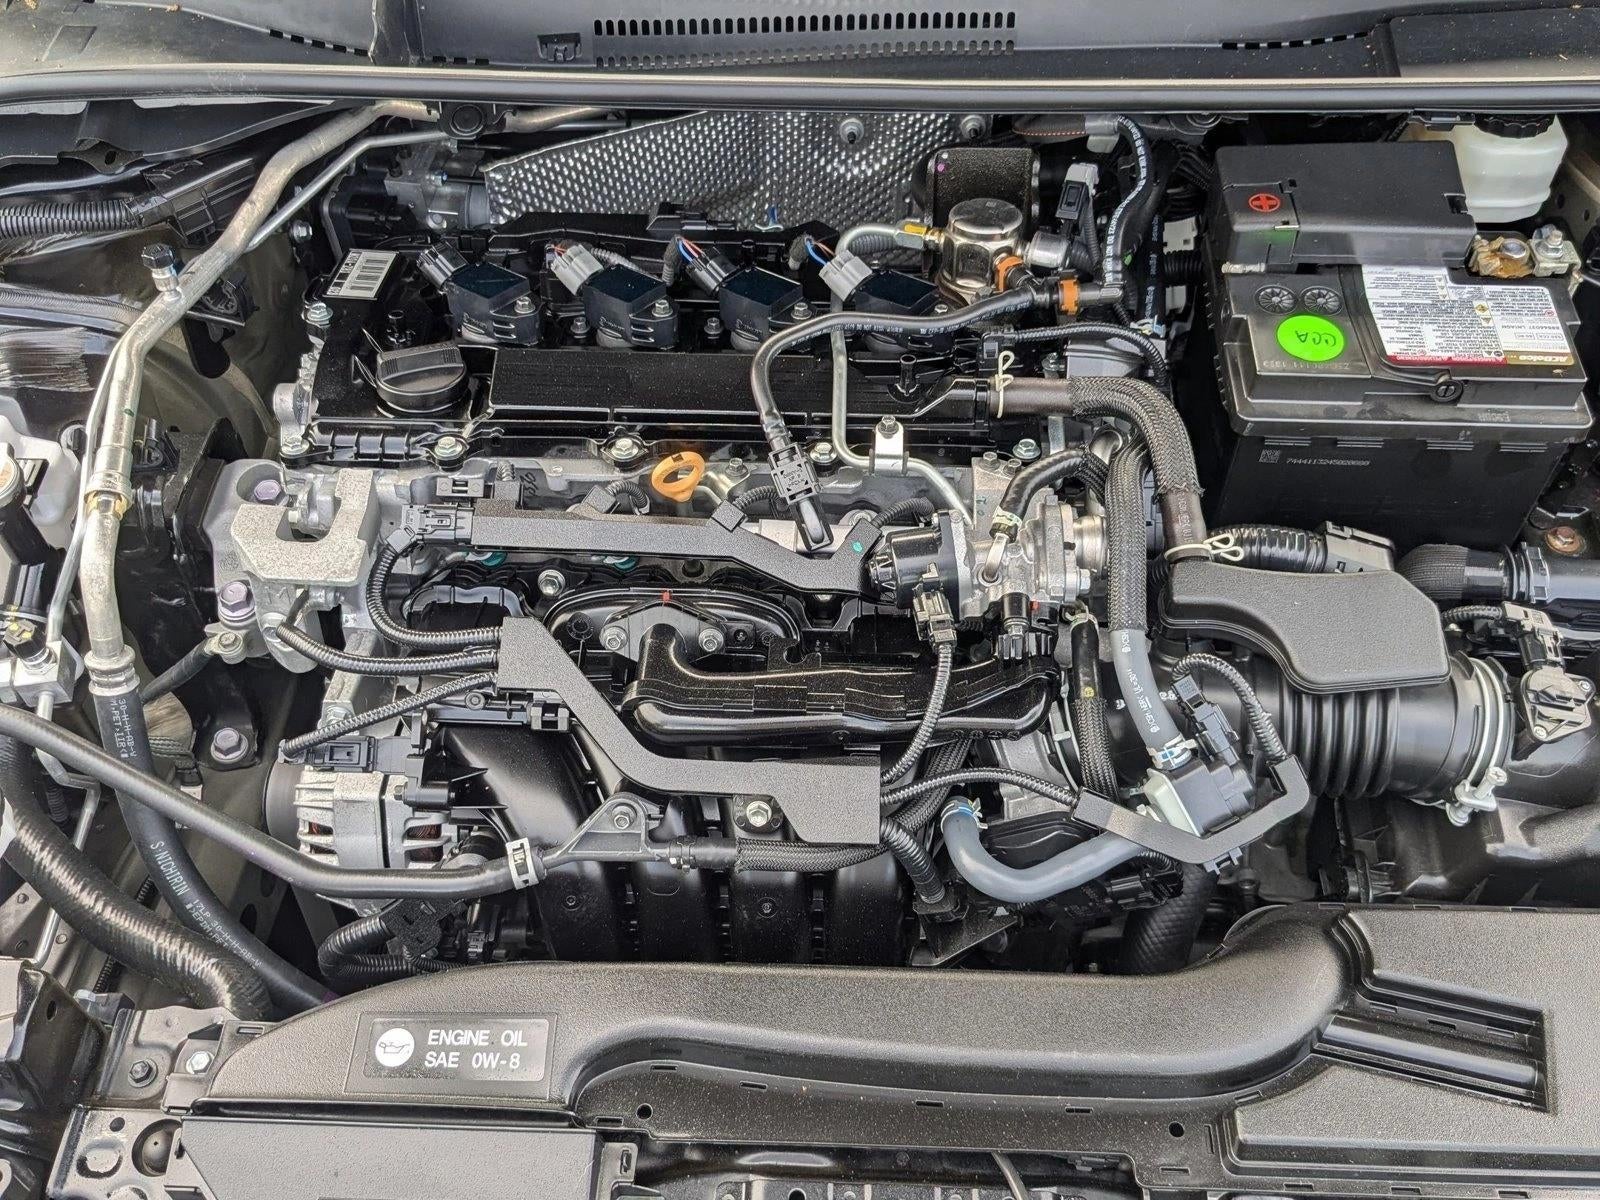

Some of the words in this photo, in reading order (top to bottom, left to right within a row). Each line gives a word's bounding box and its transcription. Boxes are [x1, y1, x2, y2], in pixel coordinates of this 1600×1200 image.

[1295, 330, 1336, 348] CCA
[427, 1029, 490, 1046] ENGINE
[500, 1029, 528, 1047] OIL
[424, 1052, 460, 1068] SAE
[471, 1053, 521, 1069] 0W-8
